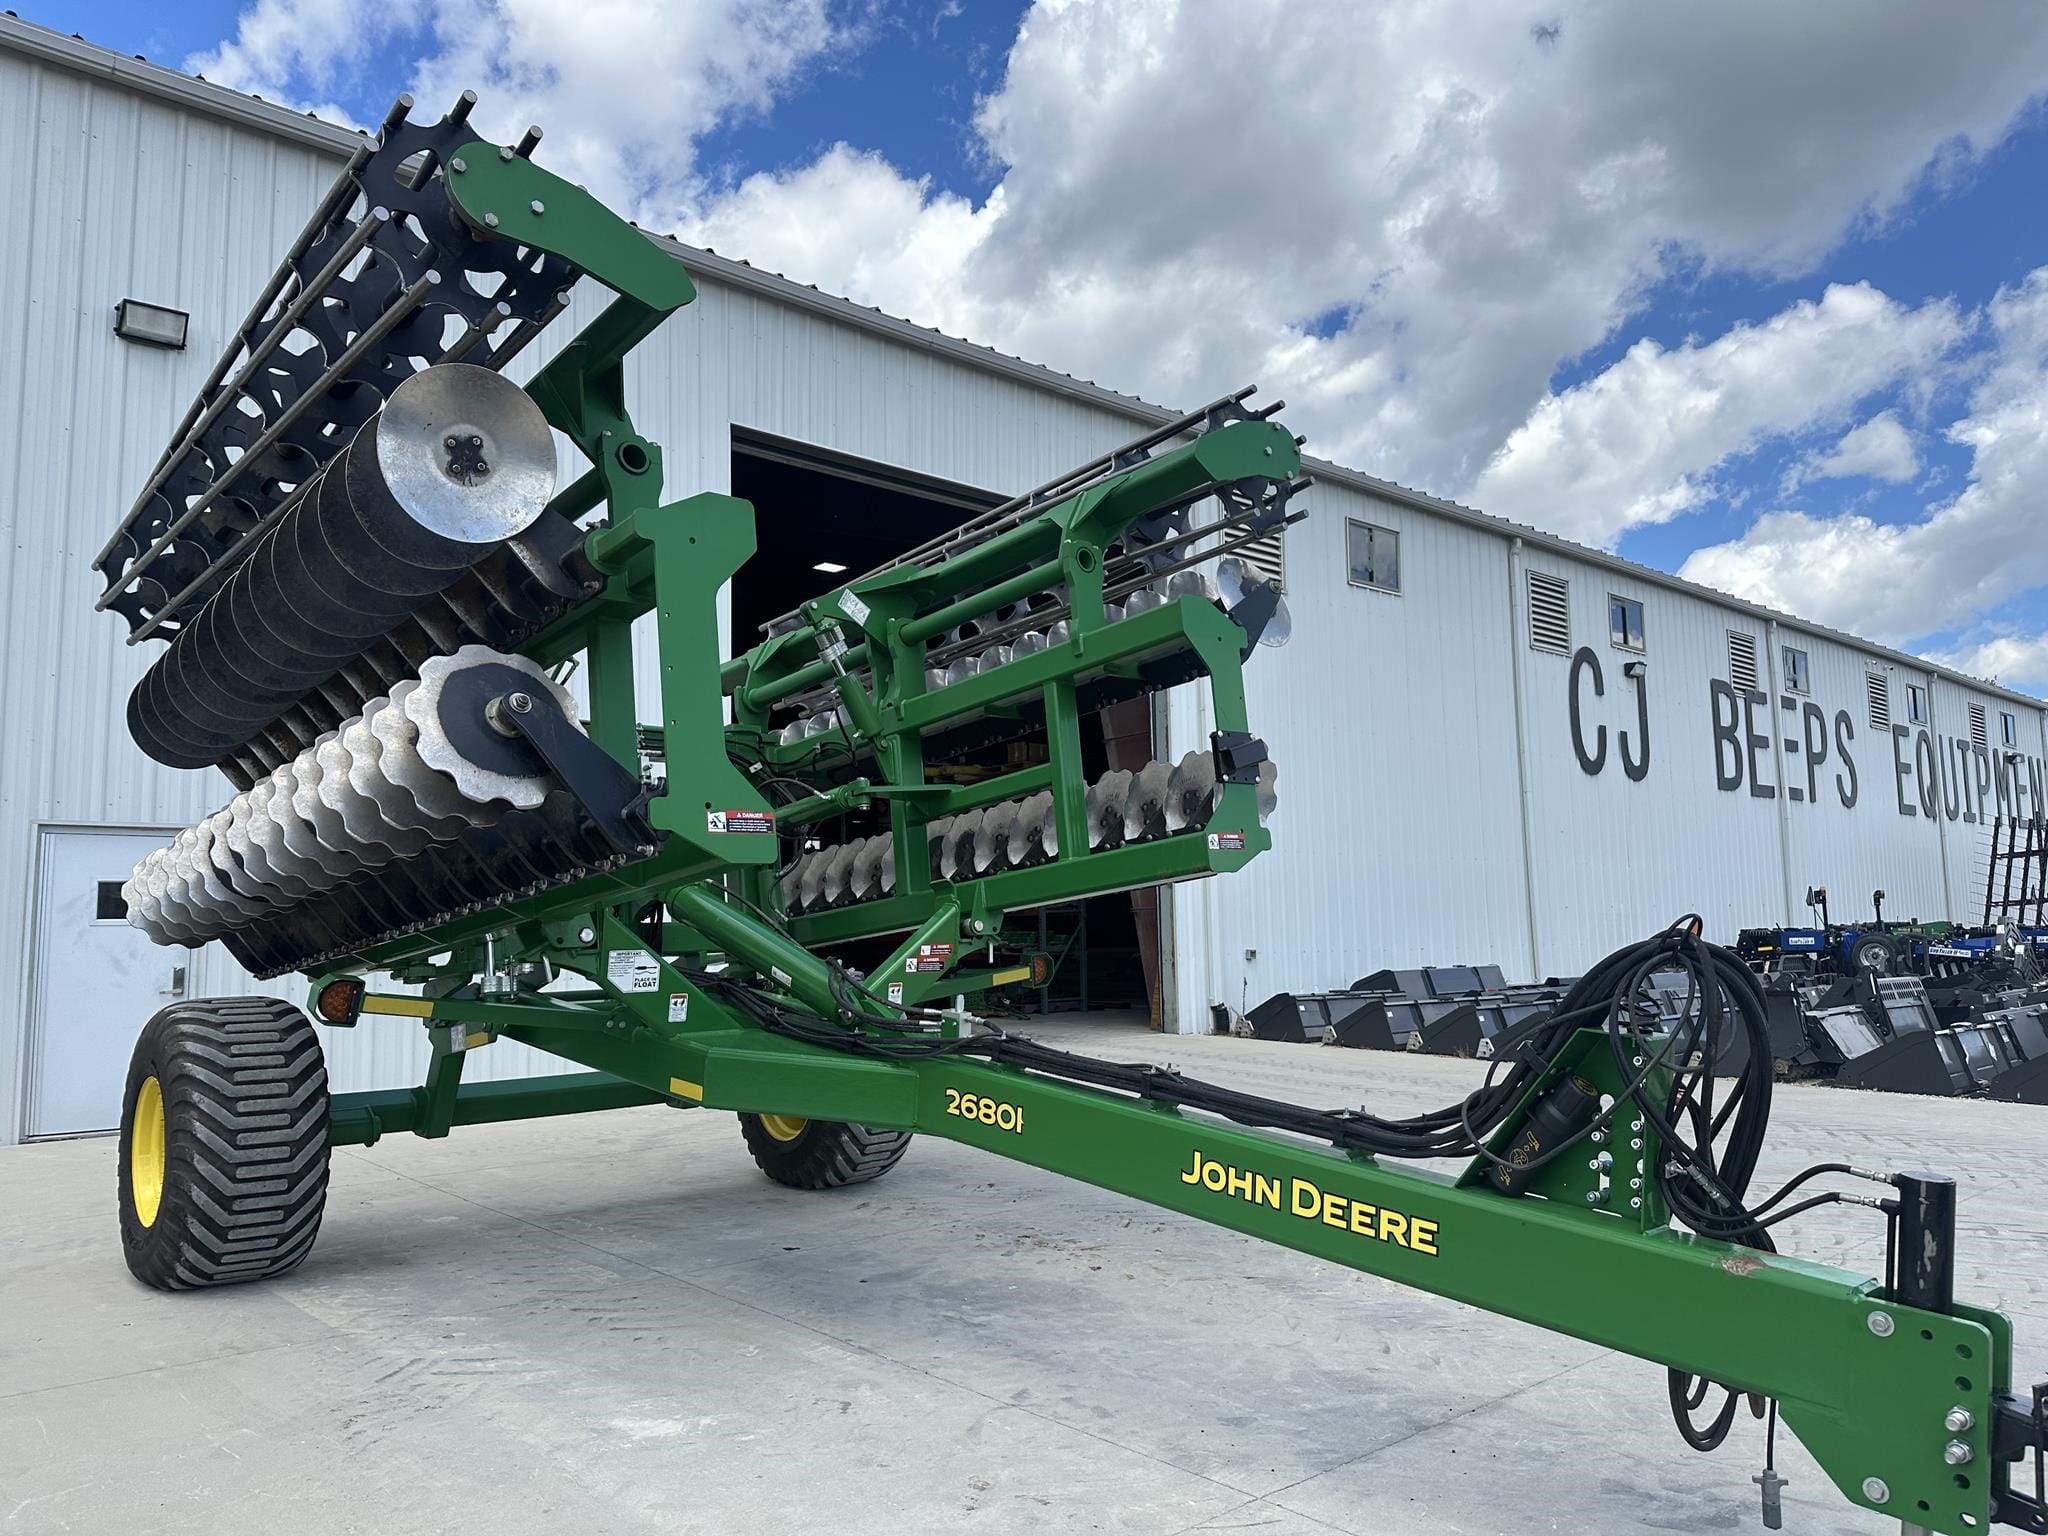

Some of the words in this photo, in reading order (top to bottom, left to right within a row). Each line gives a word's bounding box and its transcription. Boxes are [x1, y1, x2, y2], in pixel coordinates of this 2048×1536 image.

[1569, 646, 1650, 782] CJ
[1709, 677, 1858, 809] BEEPS
[1892, 723, 2048, 832] EQUIPMEN
[1180, 1149, 1283, 1212] JOHN
[1290, 1176, 1440, 1258] DEERE
